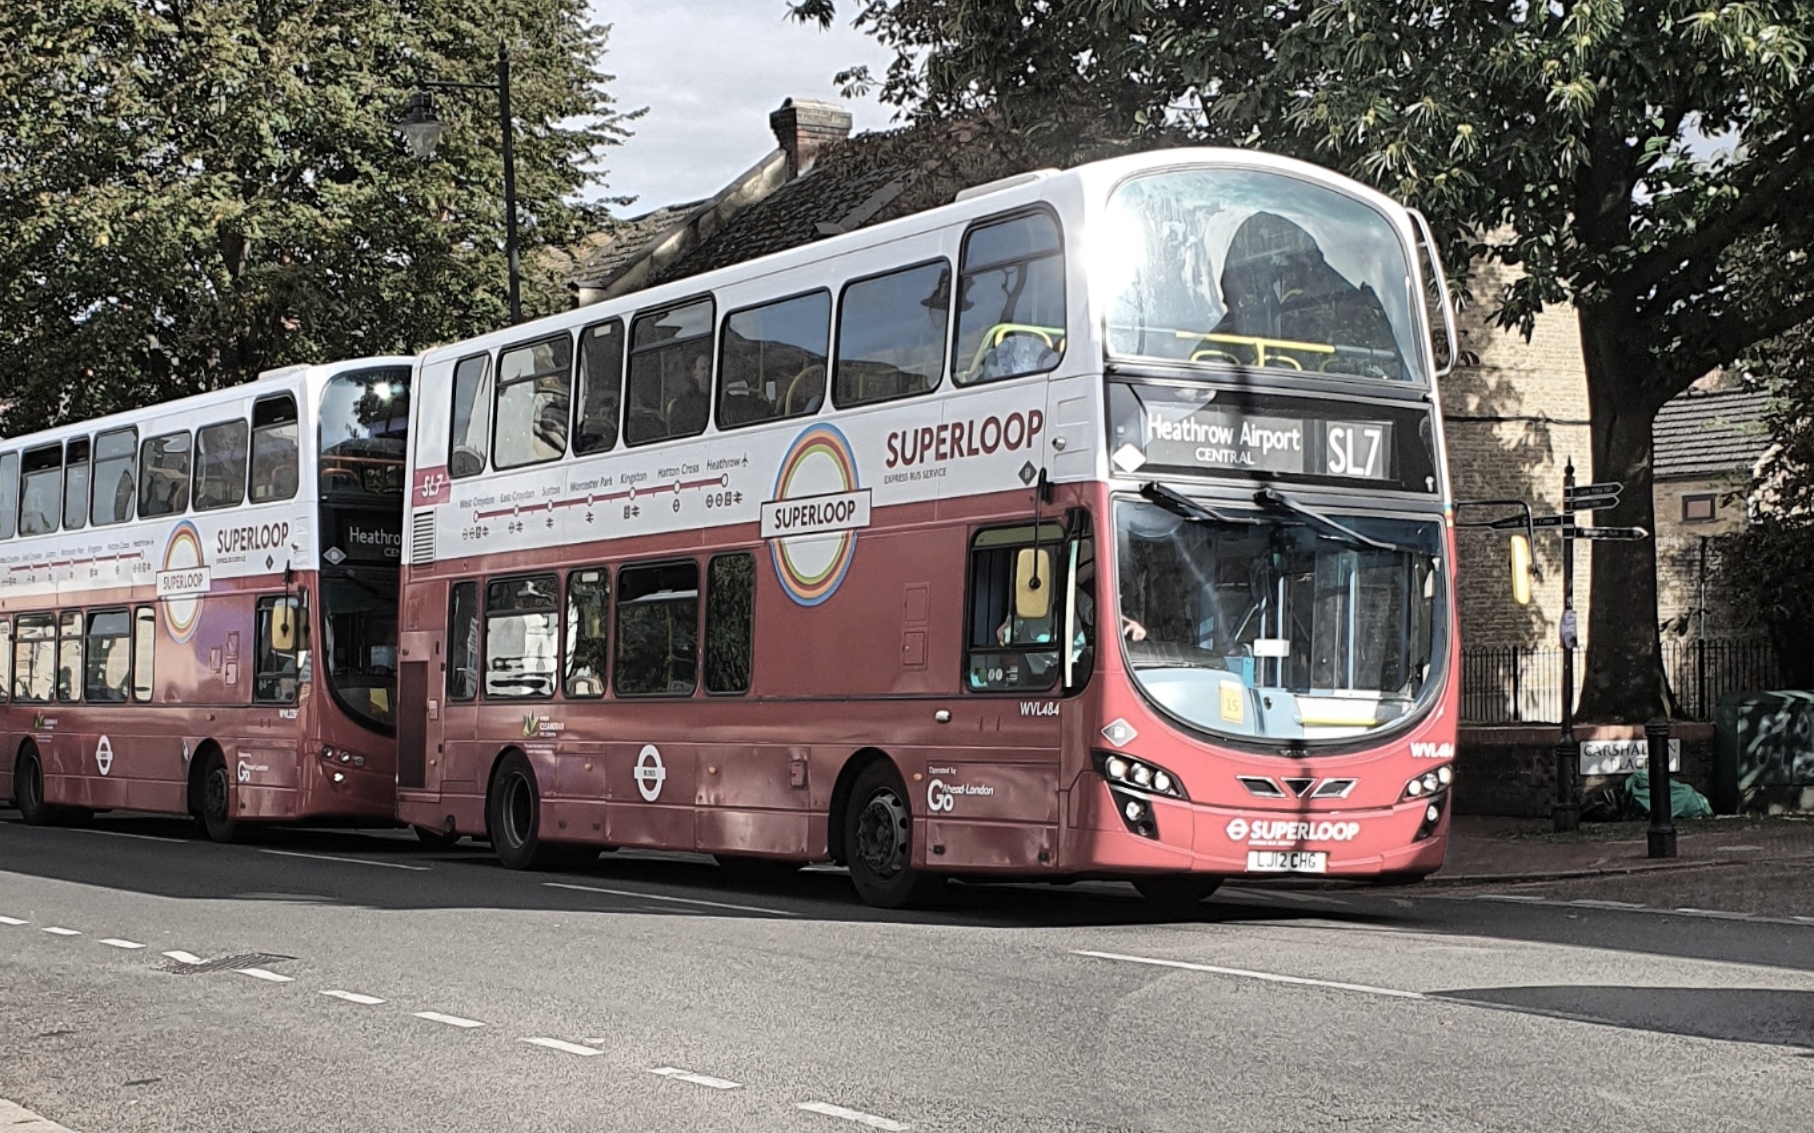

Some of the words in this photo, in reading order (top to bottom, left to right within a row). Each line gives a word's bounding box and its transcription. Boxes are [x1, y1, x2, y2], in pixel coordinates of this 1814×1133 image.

[885, 409, 1044, 469] SUPERLOOP
[1149, 412, 1233, 446] Heathrow
[1239, 421, 1301, 456] Airport
[1195, 446, 1256, 466] CENTRAL
[1328, 427, 1382, 477] SL7
[421, 474, 444, 497] SL7
[774, 500, 856, 529] SUPERLOOP
[216, 522, 289, 554] SUPERLOOP
[349, 526, 401, 545] Heathro
[163, 572, 203, 590] SUPERLOOP
[1019, 701, 1060, 716] WVL484
[1226, 698, 1239, 713] 15
[1583, 742, 1677, 758] CARSHALN
[928, 778, 954, 812] Go
[1250, 819, 1360, 841] SUPERLOOP
[1257, 851, 1288, 869] LJ12
[1290, 852, 1316, 869] CHG
